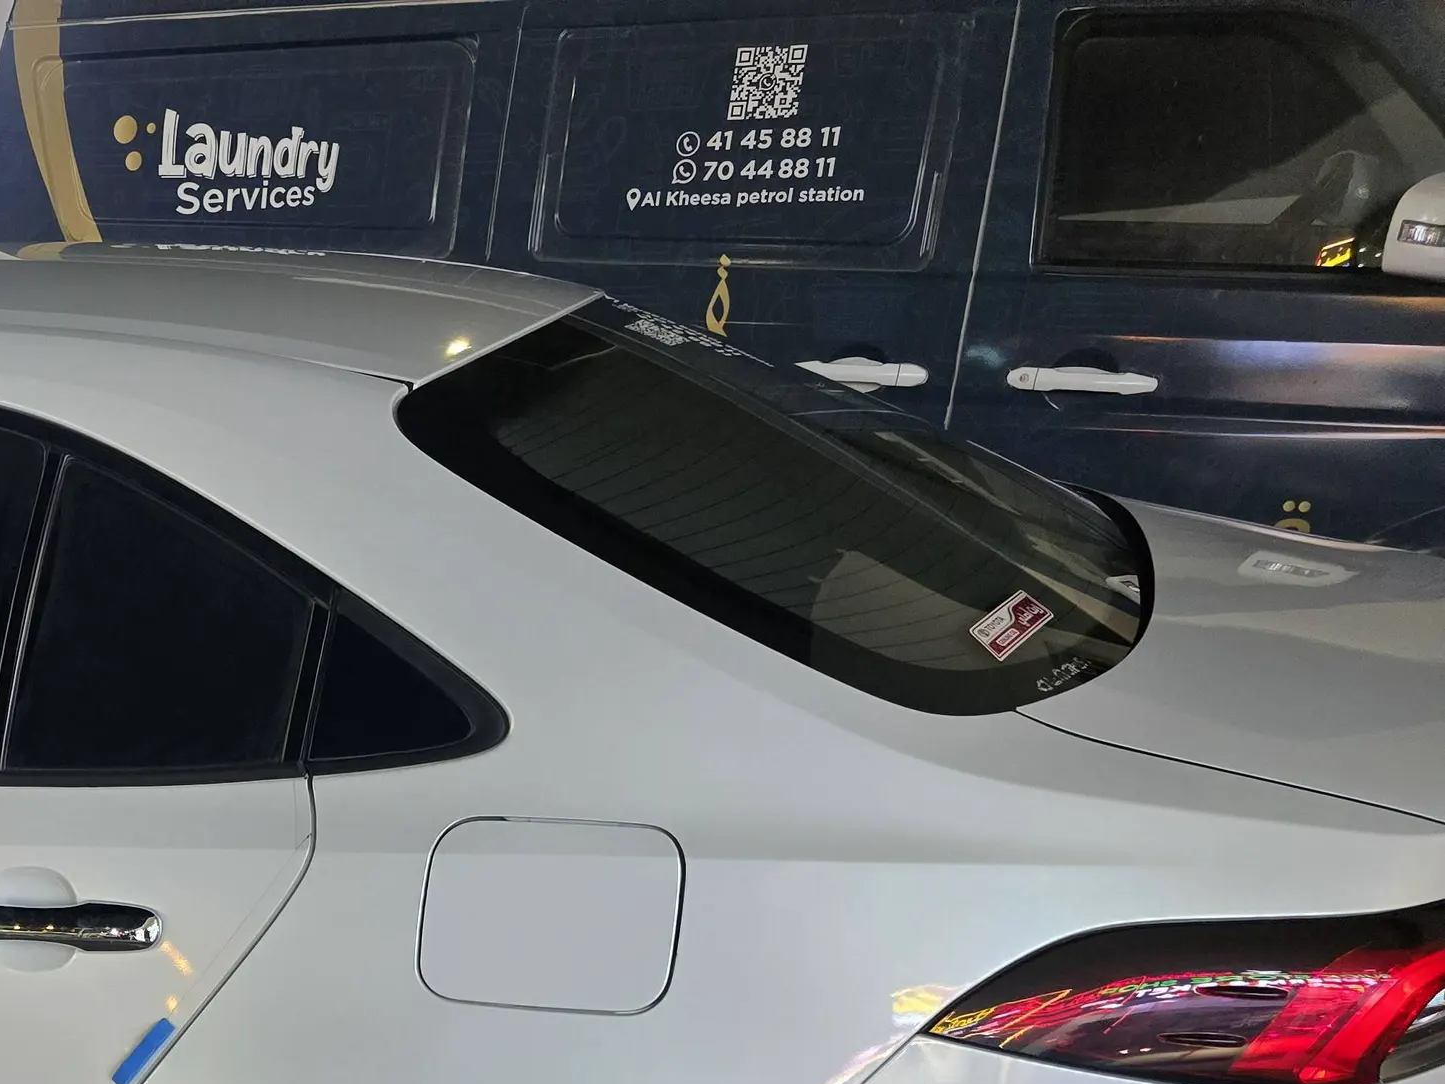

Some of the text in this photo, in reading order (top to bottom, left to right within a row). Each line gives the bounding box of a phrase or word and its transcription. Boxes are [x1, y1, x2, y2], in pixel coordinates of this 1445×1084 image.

[158, 108, 340, 193] Laundry
[706, 126, 842, 151] 41 45 88 11
[702, 157, 836, 181] 70 44 88 11
[175, 180, 316, 215] Services
[641, 186, 865, 207] Al Kheesa petrol station
[984, 616, 1006, 631] TOYOTA
